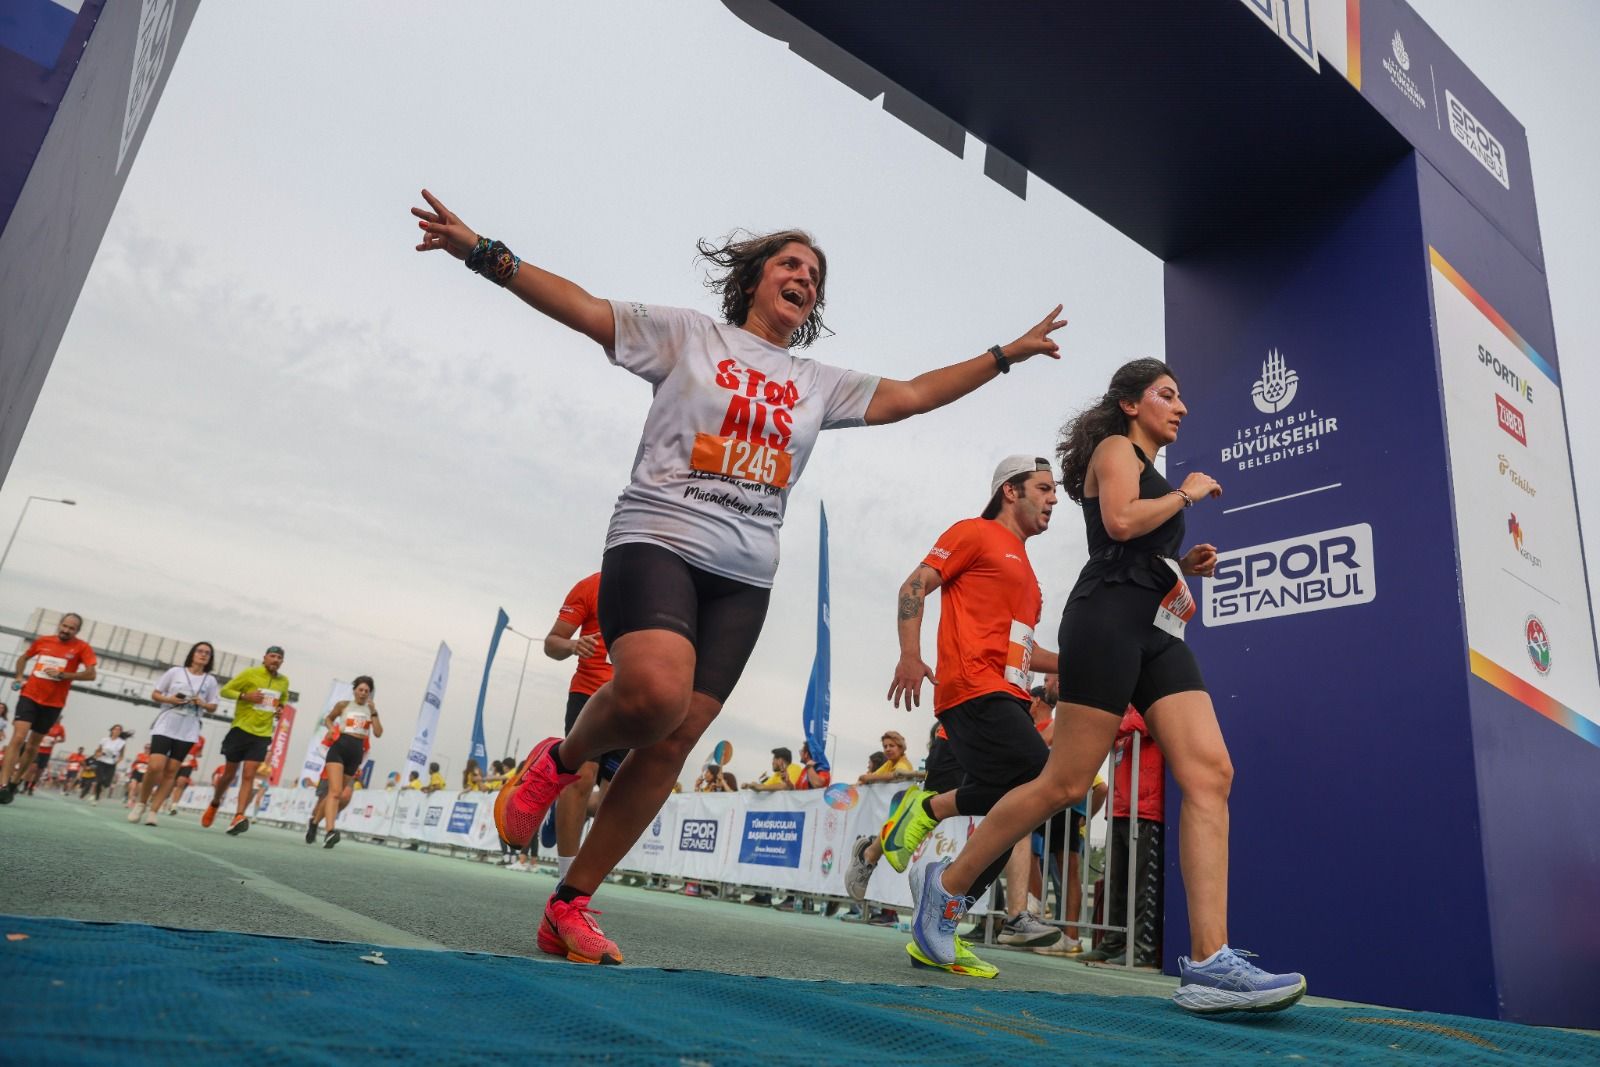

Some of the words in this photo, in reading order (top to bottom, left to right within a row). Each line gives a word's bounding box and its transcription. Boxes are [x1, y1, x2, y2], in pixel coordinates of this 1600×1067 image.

[1450, 99, 1503, 167] SPOR
[715, 358, 800, 410] STOP
[1478, 344, 1533, 404] SPORTIVE
[719, 394, 793, 451] ALS
[1221, 417, 1338, 463] BÜYÜKŞEHİR
[1237, 409, 1317, 440] İSTANBUL
[721, 439, 779, 483] 1245
[1238, 439, 1320, 471] BELEDİYESİ
[1213, 536, 1361, 594] SPOR
[683, 822, 716, 839] SPOR
